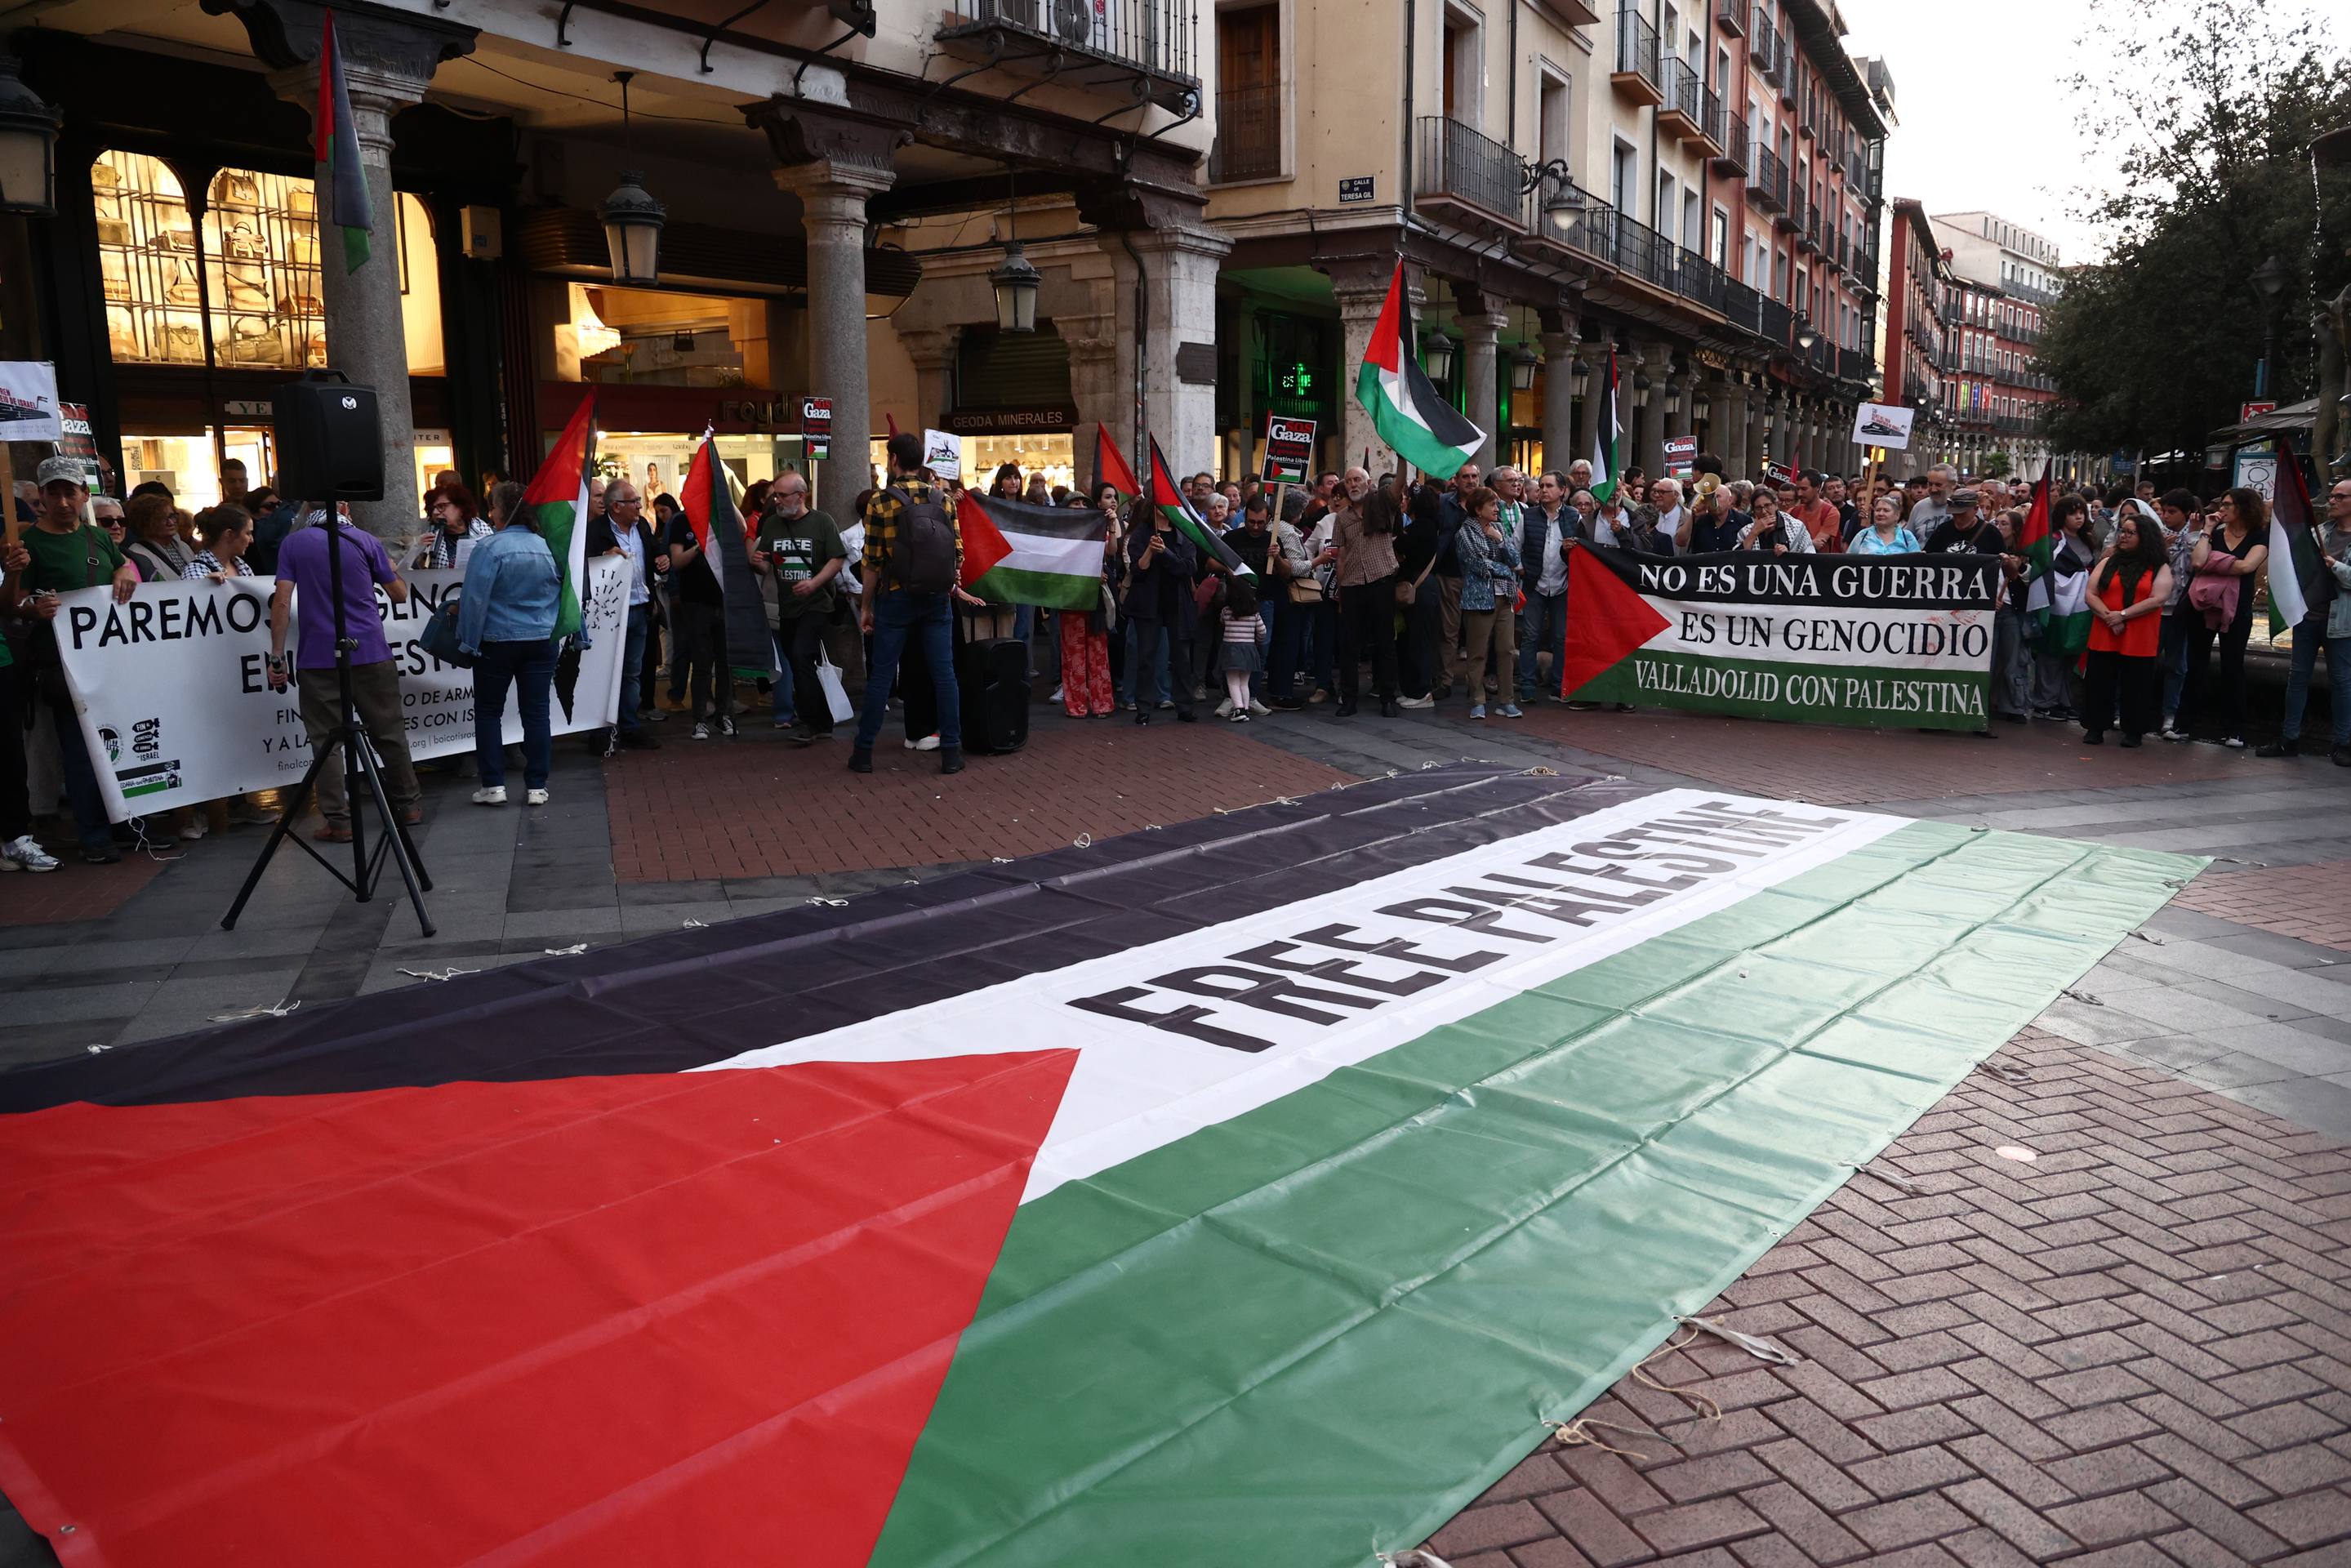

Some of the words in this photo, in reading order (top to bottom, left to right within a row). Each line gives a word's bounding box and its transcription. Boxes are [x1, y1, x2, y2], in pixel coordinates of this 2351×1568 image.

[1341, 192, 1363, 201] TERESA
[17, 399, 38, 410] ISRAEL
[804, 403, 831, 419] Gaza
[61, 419, 92, 434] aza
[953, 416, 993, 428] GEODA
[998, 412, 1062, 425] MINERALES
[1271, 424, 1311, 443] Gaza
[1664, 442, 1695, 453] Gaza
[1267, 454, 1294, 463] Palestina
[1767, 466, 1790, 483] Gaz
[773, 539, 812, 551] FREE
[777, 569, 812, 580] LESTINE
[1638, 564, 1687, 592] NO
[1696, 566, 1737, 595] ES
[1747, 564, 1822, 597] UNA
[1832, 566, 1991, 600] GUERRA
[1678, 611, 1716, 644] ES
[1726, 614, 1775, 648] UN
[1783, 617, 1989, 658] GENOCIDIO
[1634, 659, 1779, 702] VALLADOLID
[1785, 675, 1837, 706] CON
[1845, 678, 1985, 716] PALESTINA
[421, 690, 440, 706] DE
[444, 686, 474, 702] ARM
[262, 738, 274, 753] Y
[279, 736, 291, 751] A
[424, 710, 457, 727] CON
[140, 752, 159, 761] ISRAEL
[1066, 923, 1509, 1053] FREE
[1374, 800, 1855, 944] PALESTINE
